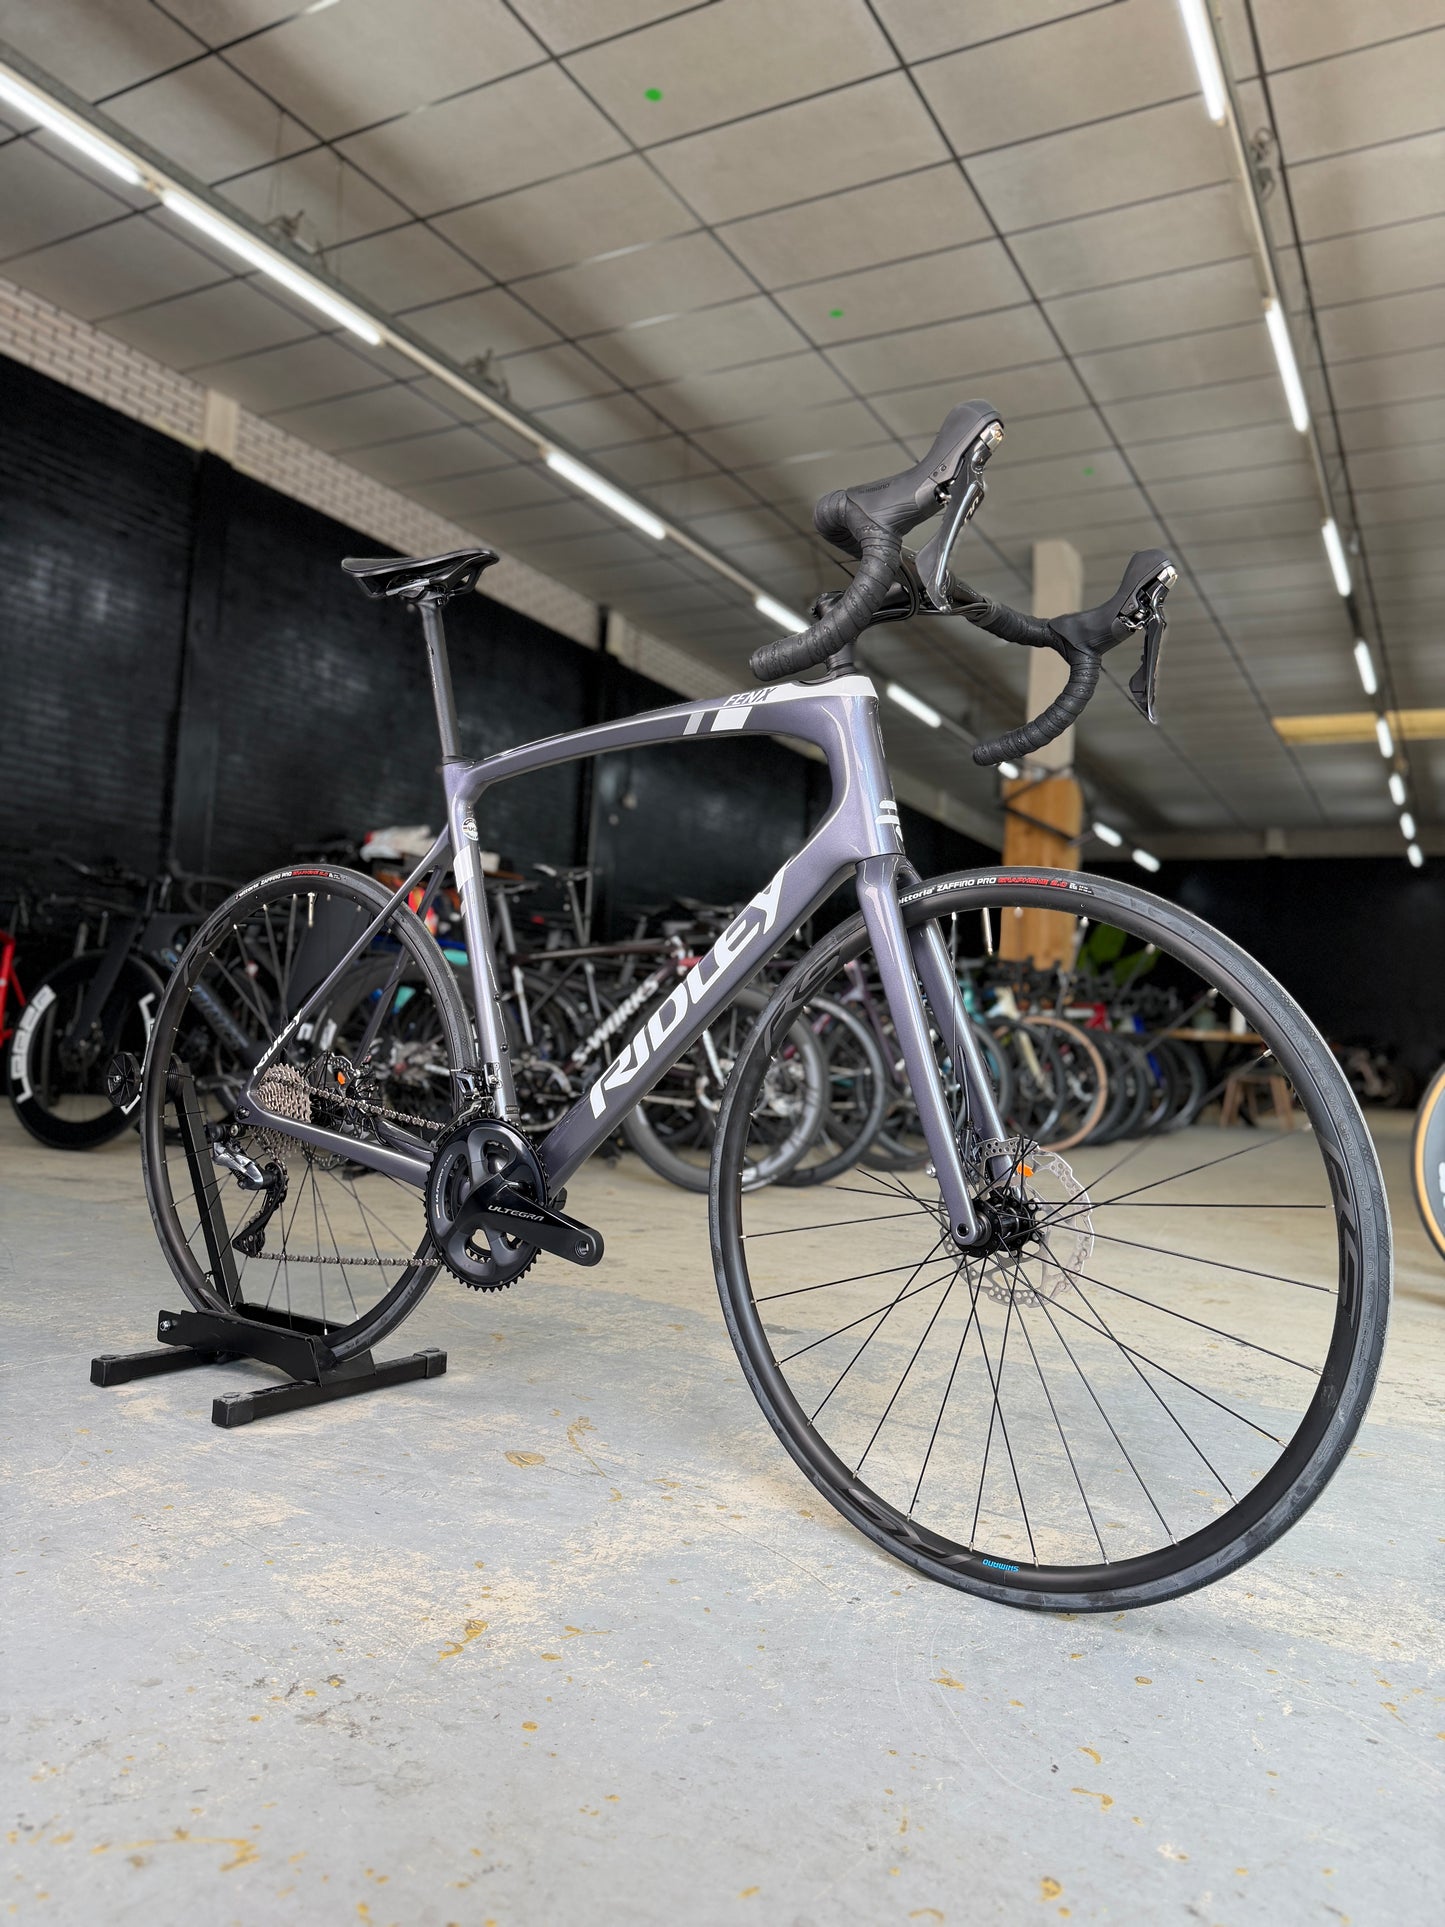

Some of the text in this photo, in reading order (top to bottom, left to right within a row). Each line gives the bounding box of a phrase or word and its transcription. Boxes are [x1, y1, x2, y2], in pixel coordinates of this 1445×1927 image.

[899, 886, 936, 905] ittoria
[976, 877, 997, 886] PRO
[589, 864, 786, 1119] RIDLEY
[487, 1204, 545, 1222] ULTEGRA
[982, 1558, 1020, 1572] SHIMANO
